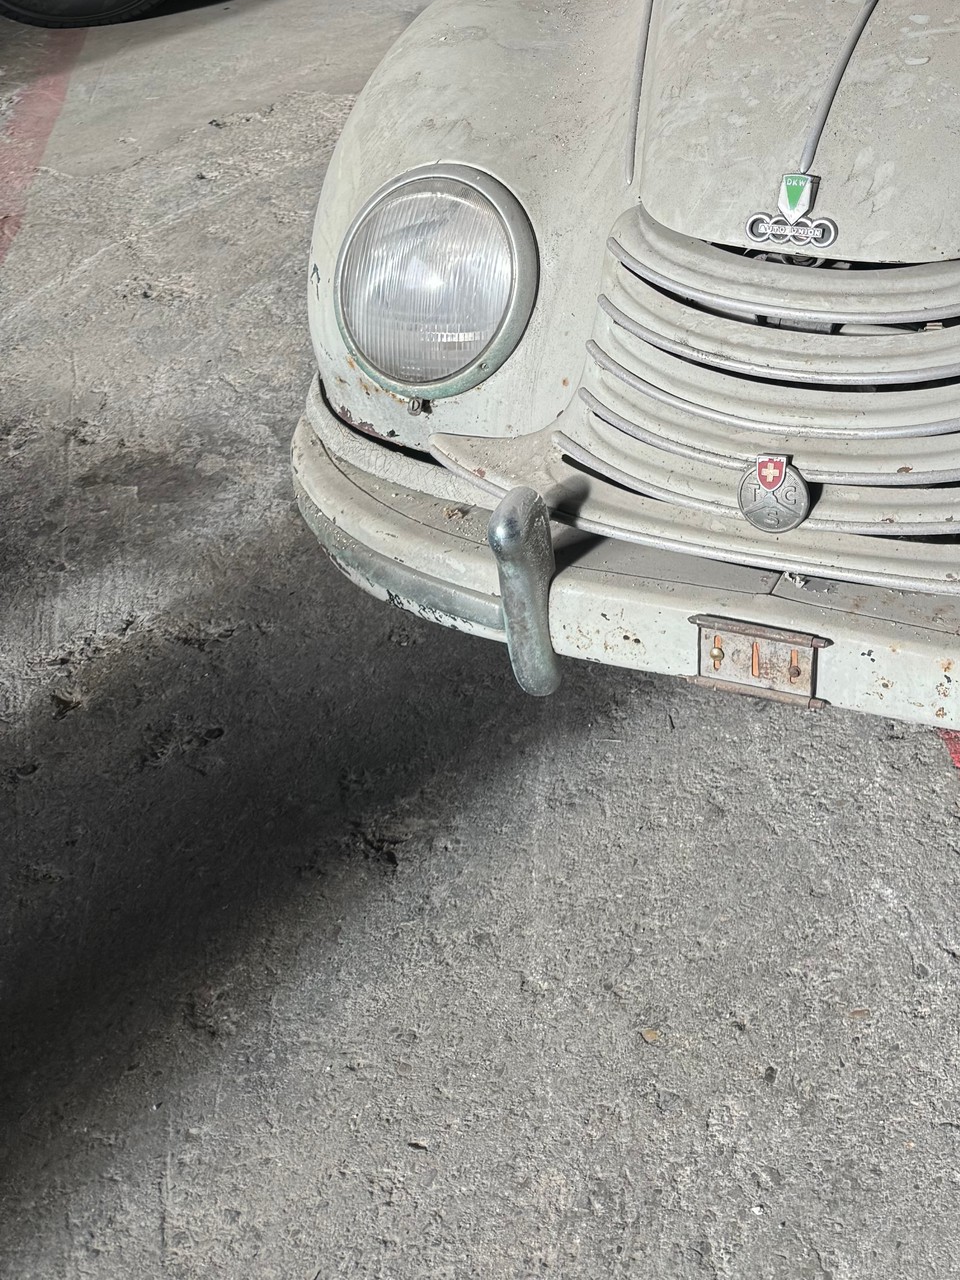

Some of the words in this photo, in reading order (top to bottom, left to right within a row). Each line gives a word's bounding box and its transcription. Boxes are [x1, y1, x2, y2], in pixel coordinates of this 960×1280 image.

[786, 178, 806, 187] DKW
[758, 223, 785, 235] AUTO
[791, 226, 823, 238] UNION
